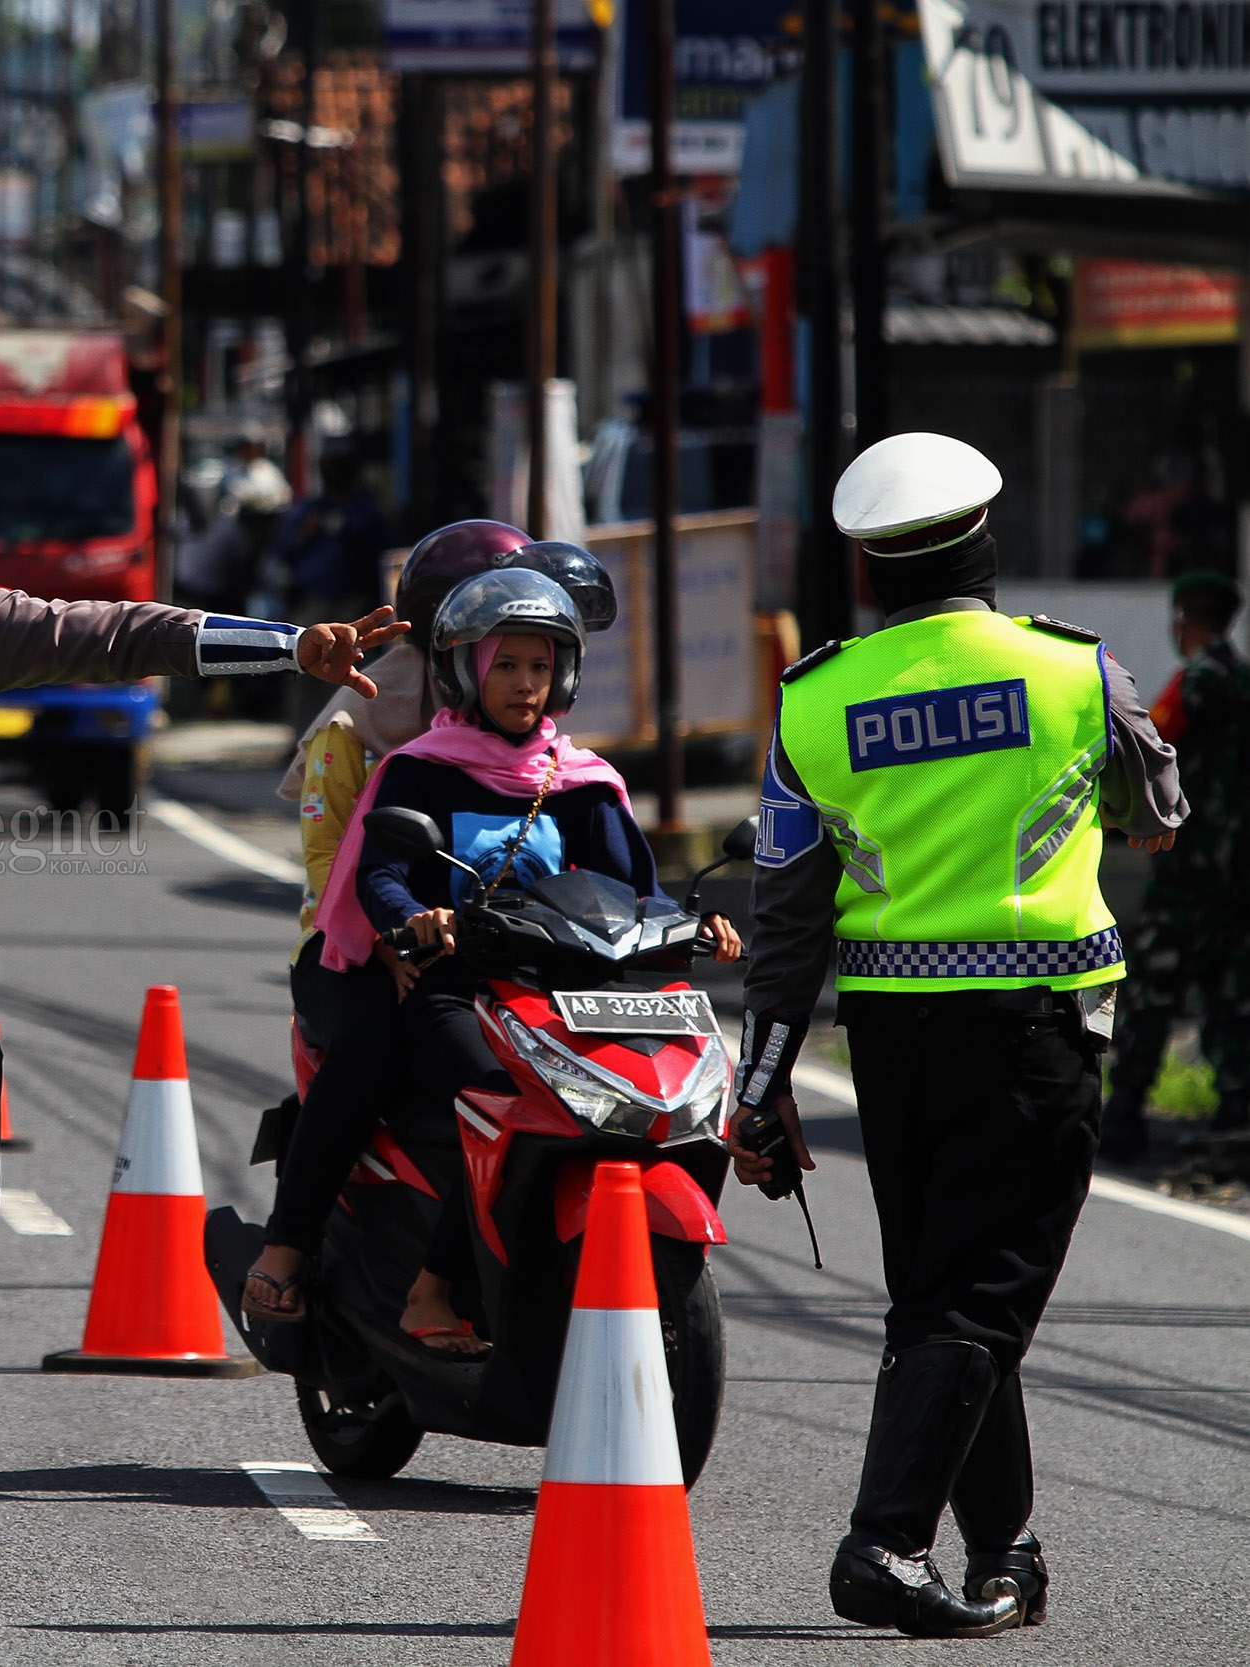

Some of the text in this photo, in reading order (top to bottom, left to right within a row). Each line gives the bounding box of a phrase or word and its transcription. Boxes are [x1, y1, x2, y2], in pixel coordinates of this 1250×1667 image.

[854, 688, 1026, 759] POLISI
[571, 997, 600, 1015] AB
[607, 999, 672, 1017] 3292
